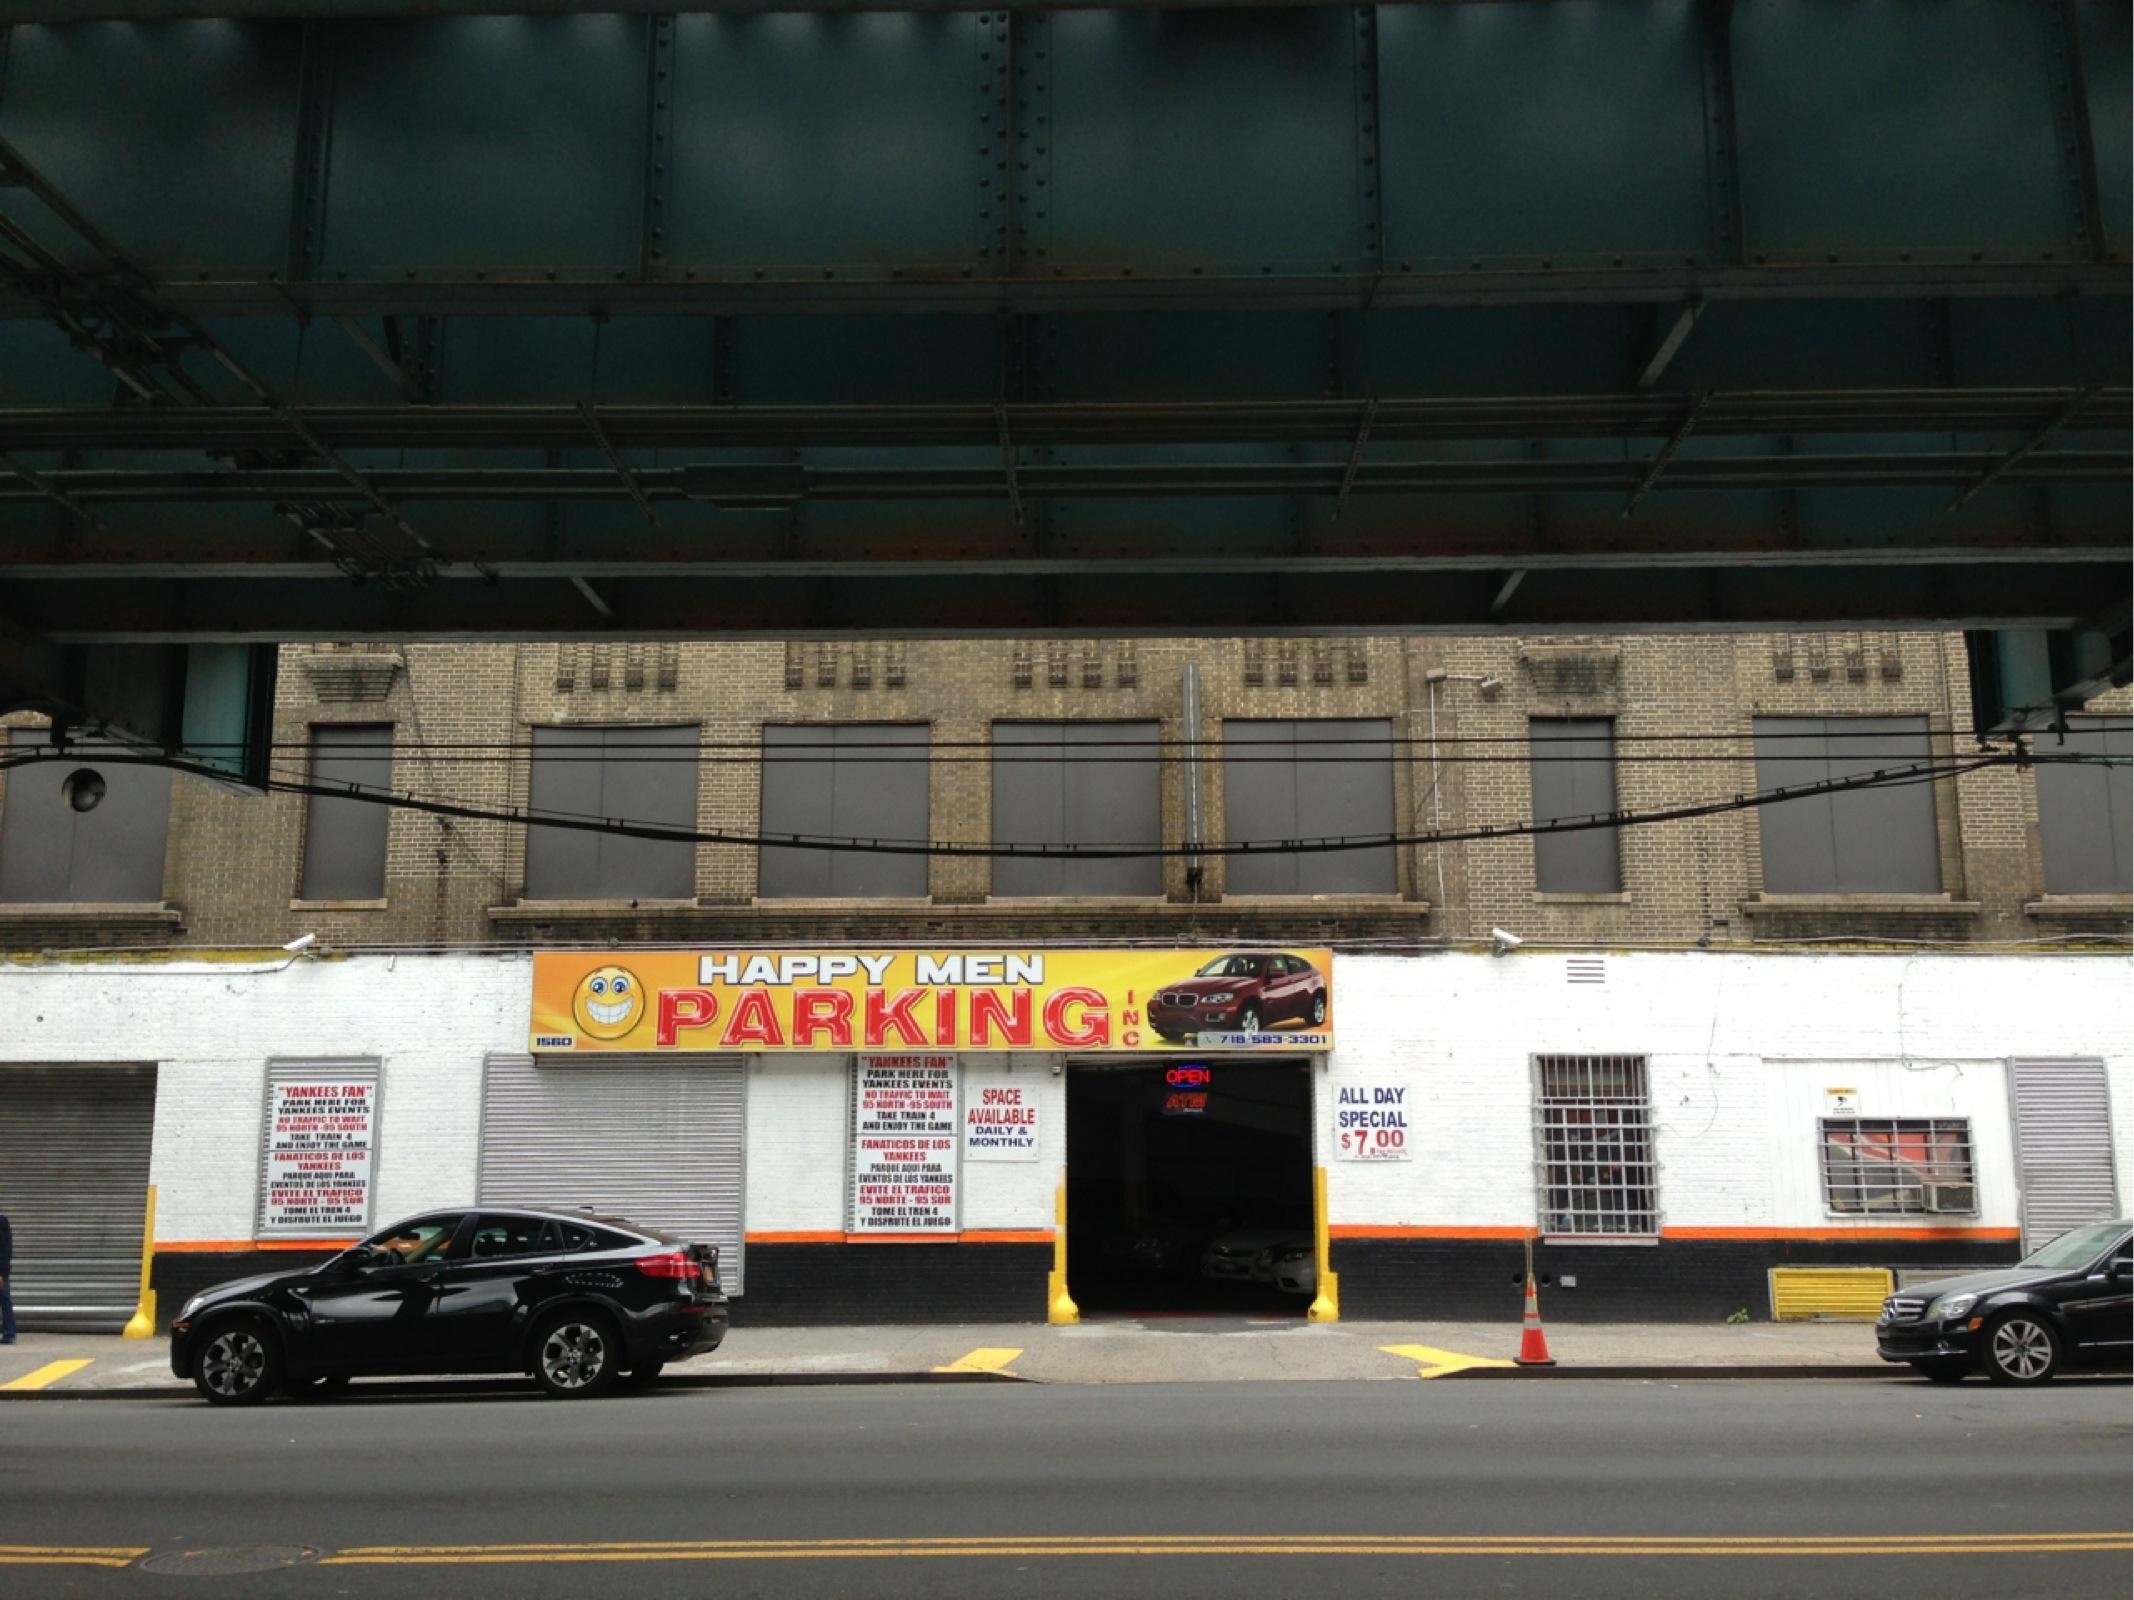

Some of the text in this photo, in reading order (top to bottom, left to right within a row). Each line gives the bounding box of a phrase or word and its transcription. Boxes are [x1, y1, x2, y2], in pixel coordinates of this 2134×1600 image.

[698, 954, 1044, 986] HAPPY MEN
[656, 986, 1112, 1047] PARKING
[536, 1037, 573, 1047] 1560
[1220, 1034, 1327, 1044] 718-583-3301
[867, 1070, 948, 1078] PARK HERE FOR
[1166, 1070, 1211, 1083] OPEN
[863, 1080, 952, 1088] YANKEES EVENTS
[865, 1090, 949, 1098] NO TRAFFIC TO WAIT
[982, 1089, 1022, 1105] SPACE
[1339, 1087, 1405, 1104] ALL DAY
[877, 1112, 936, 1120] TAKE TRAIN 4
[968, 1108, 1035, 1124] AVAILABLE
[1339, 1111, 1407, 1128] SPECIAL
[863, 1122, 952, 1130] AND ENJOY THE GAME
[975, 1126, 1027, 1135] DAILY &
[862, 1140, 951, 1149] FANATICOS DE LOS
[969, 1138, 1034, 1147] MONTHLY
[1341, 1130, 1404, 1155] $7.00
[883, 1152, 927, 1161] YANKEES
[298, 1162, 341, 1170] YANKEES
[871, 1163, 942, 1172] PARQUE AQUI PARA
[859, 1174, 952, 1183] EVENTOS DE LOS YANKEES
[861, 1185, 950, 1194] EVITE EL TRAFICO
[860, 1196, 873, 1204] 95
[875, 1196, 906, 1204] NORTE
[915, 1196, 928, 1204] 95
[931, 1196, 951, 1204] SUR
[872, 1207, 938, 1215] TOME EL TREN 4
[861, 1218, 951, 1226] Y DISFRUTE EL JUEGO
